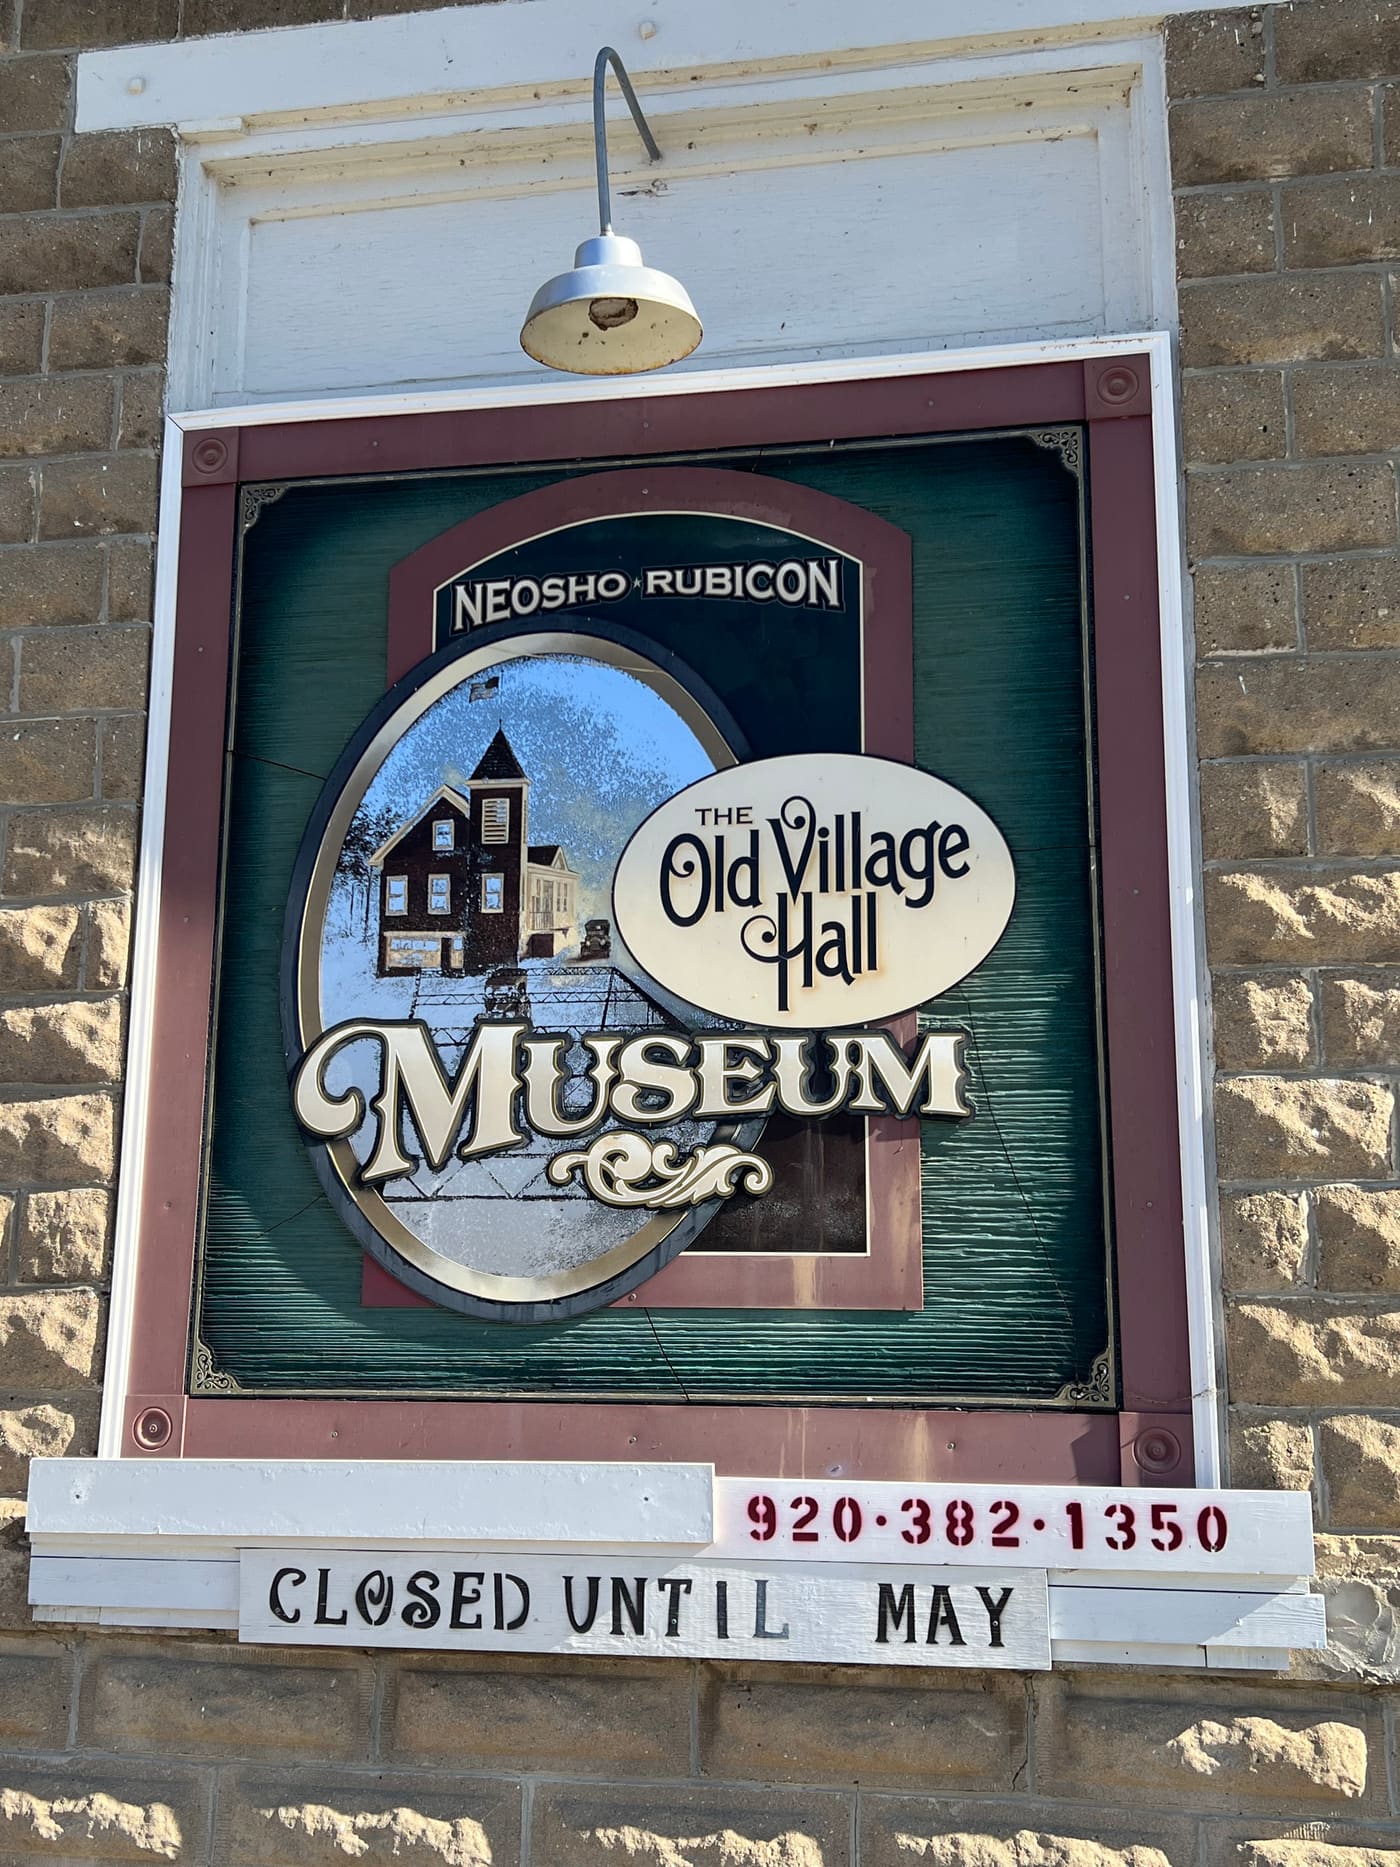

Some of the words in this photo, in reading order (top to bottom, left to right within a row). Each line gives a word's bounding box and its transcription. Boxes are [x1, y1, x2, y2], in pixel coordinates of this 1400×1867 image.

[452, 571, 628, 632] NEOSHO
[645, 558, 841, 608] RUBICON
[660, 829, 763, 928] Old
[766, 796, 971, 909] Village
[695, 807, 753, 826] THE
[740, 891, 878, 1012] Hall
[298, 1019, 974, 1183] MUSEUM
[269, 1567, 531, 1631] CLOSED
[562, 1575, 790, 1640] UNTIL
[875, 1583, 1015, 1648] MAY
